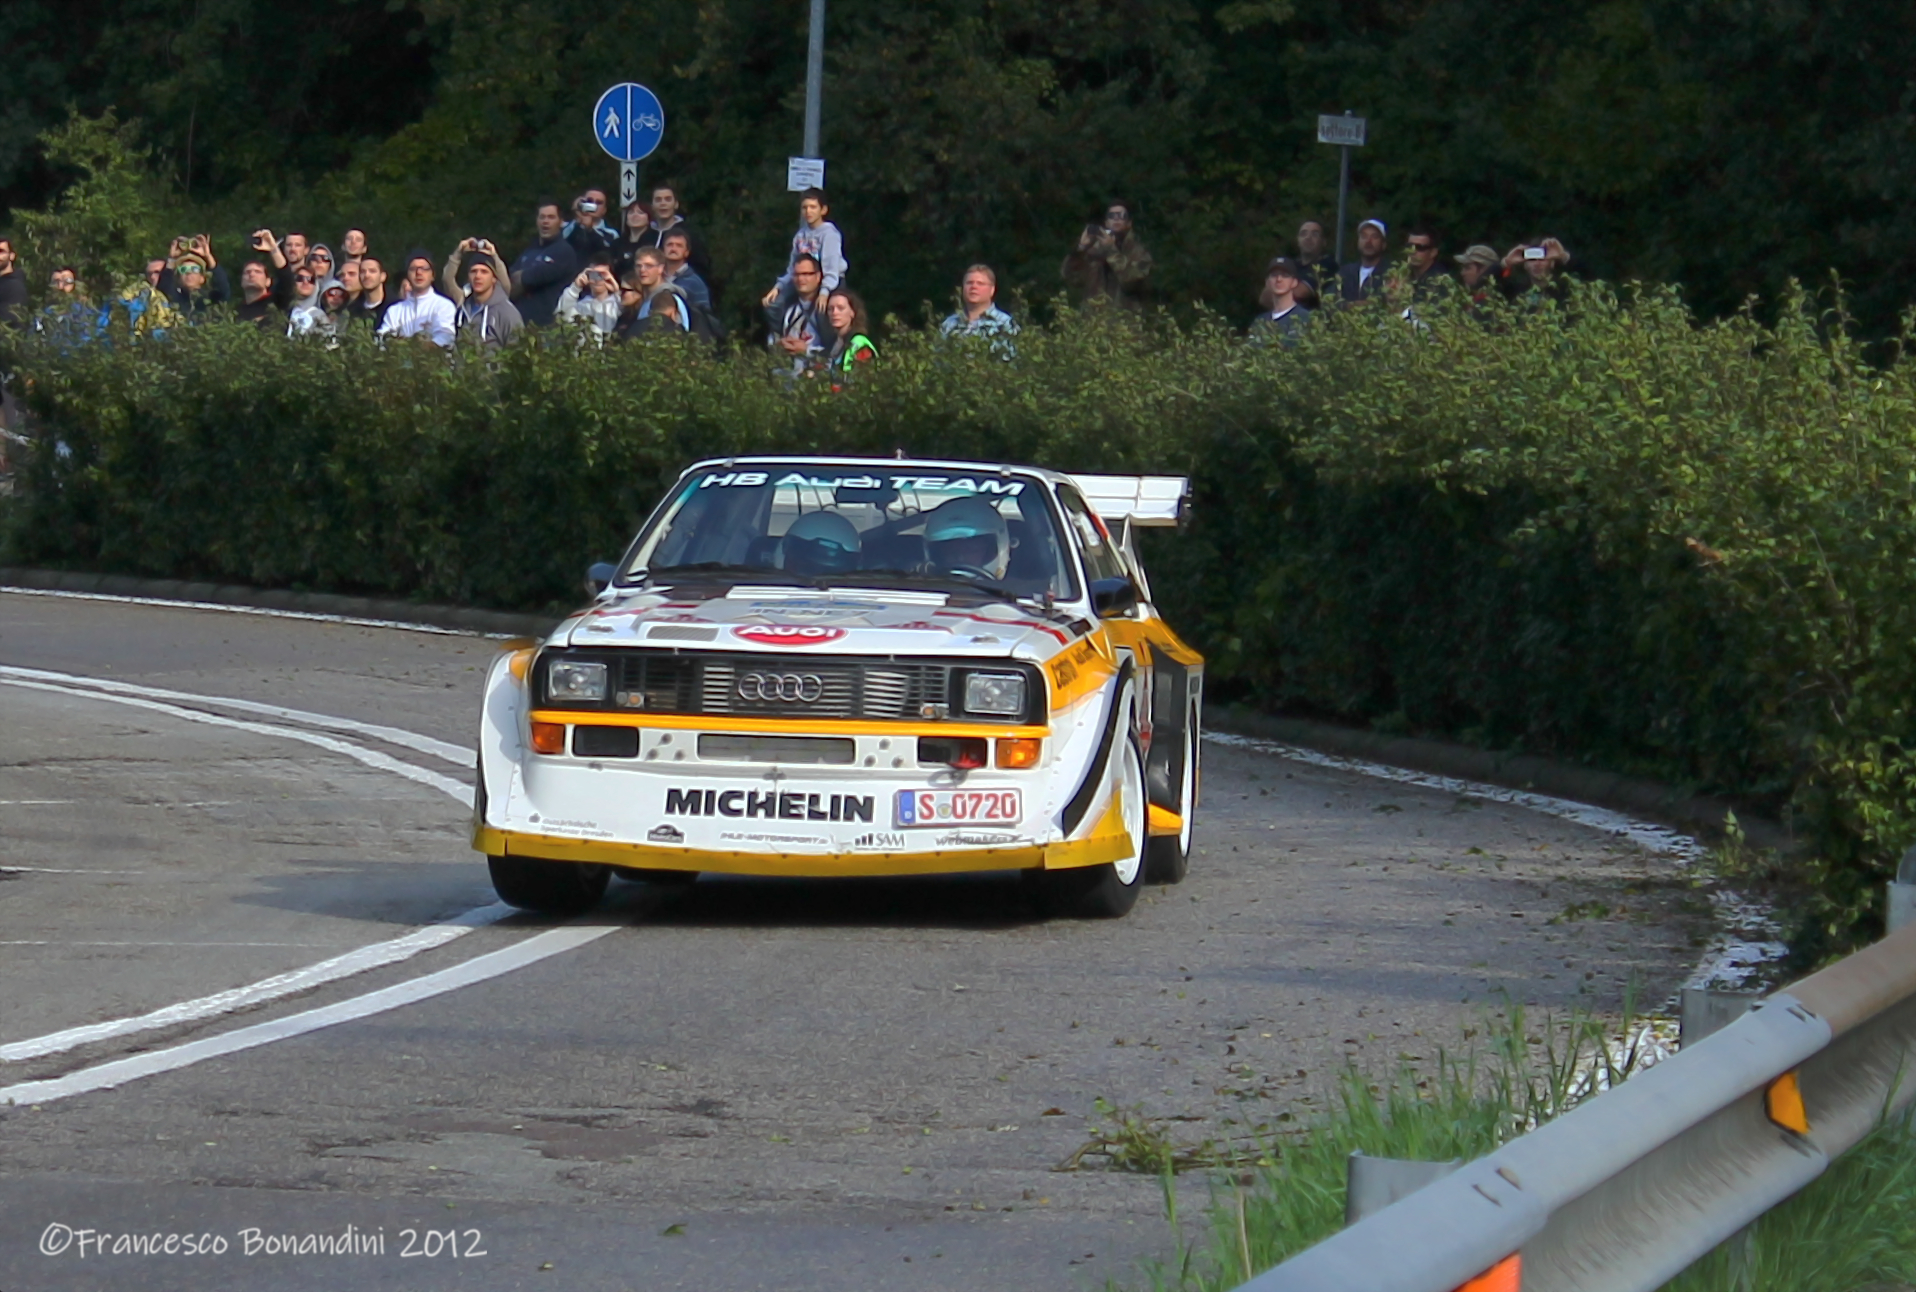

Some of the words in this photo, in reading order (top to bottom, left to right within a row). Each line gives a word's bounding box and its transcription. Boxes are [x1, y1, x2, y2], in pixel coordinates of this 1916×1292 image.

[699, 473, 769, 489] HB
[889, 476, 1026, 497] TEAM
[664, 788, 876, 823] MICHELIN
[918, 793, 936, 821] S
[951, 792, 1018, 820] 0720
[875, 832, 906, 847] SAM
